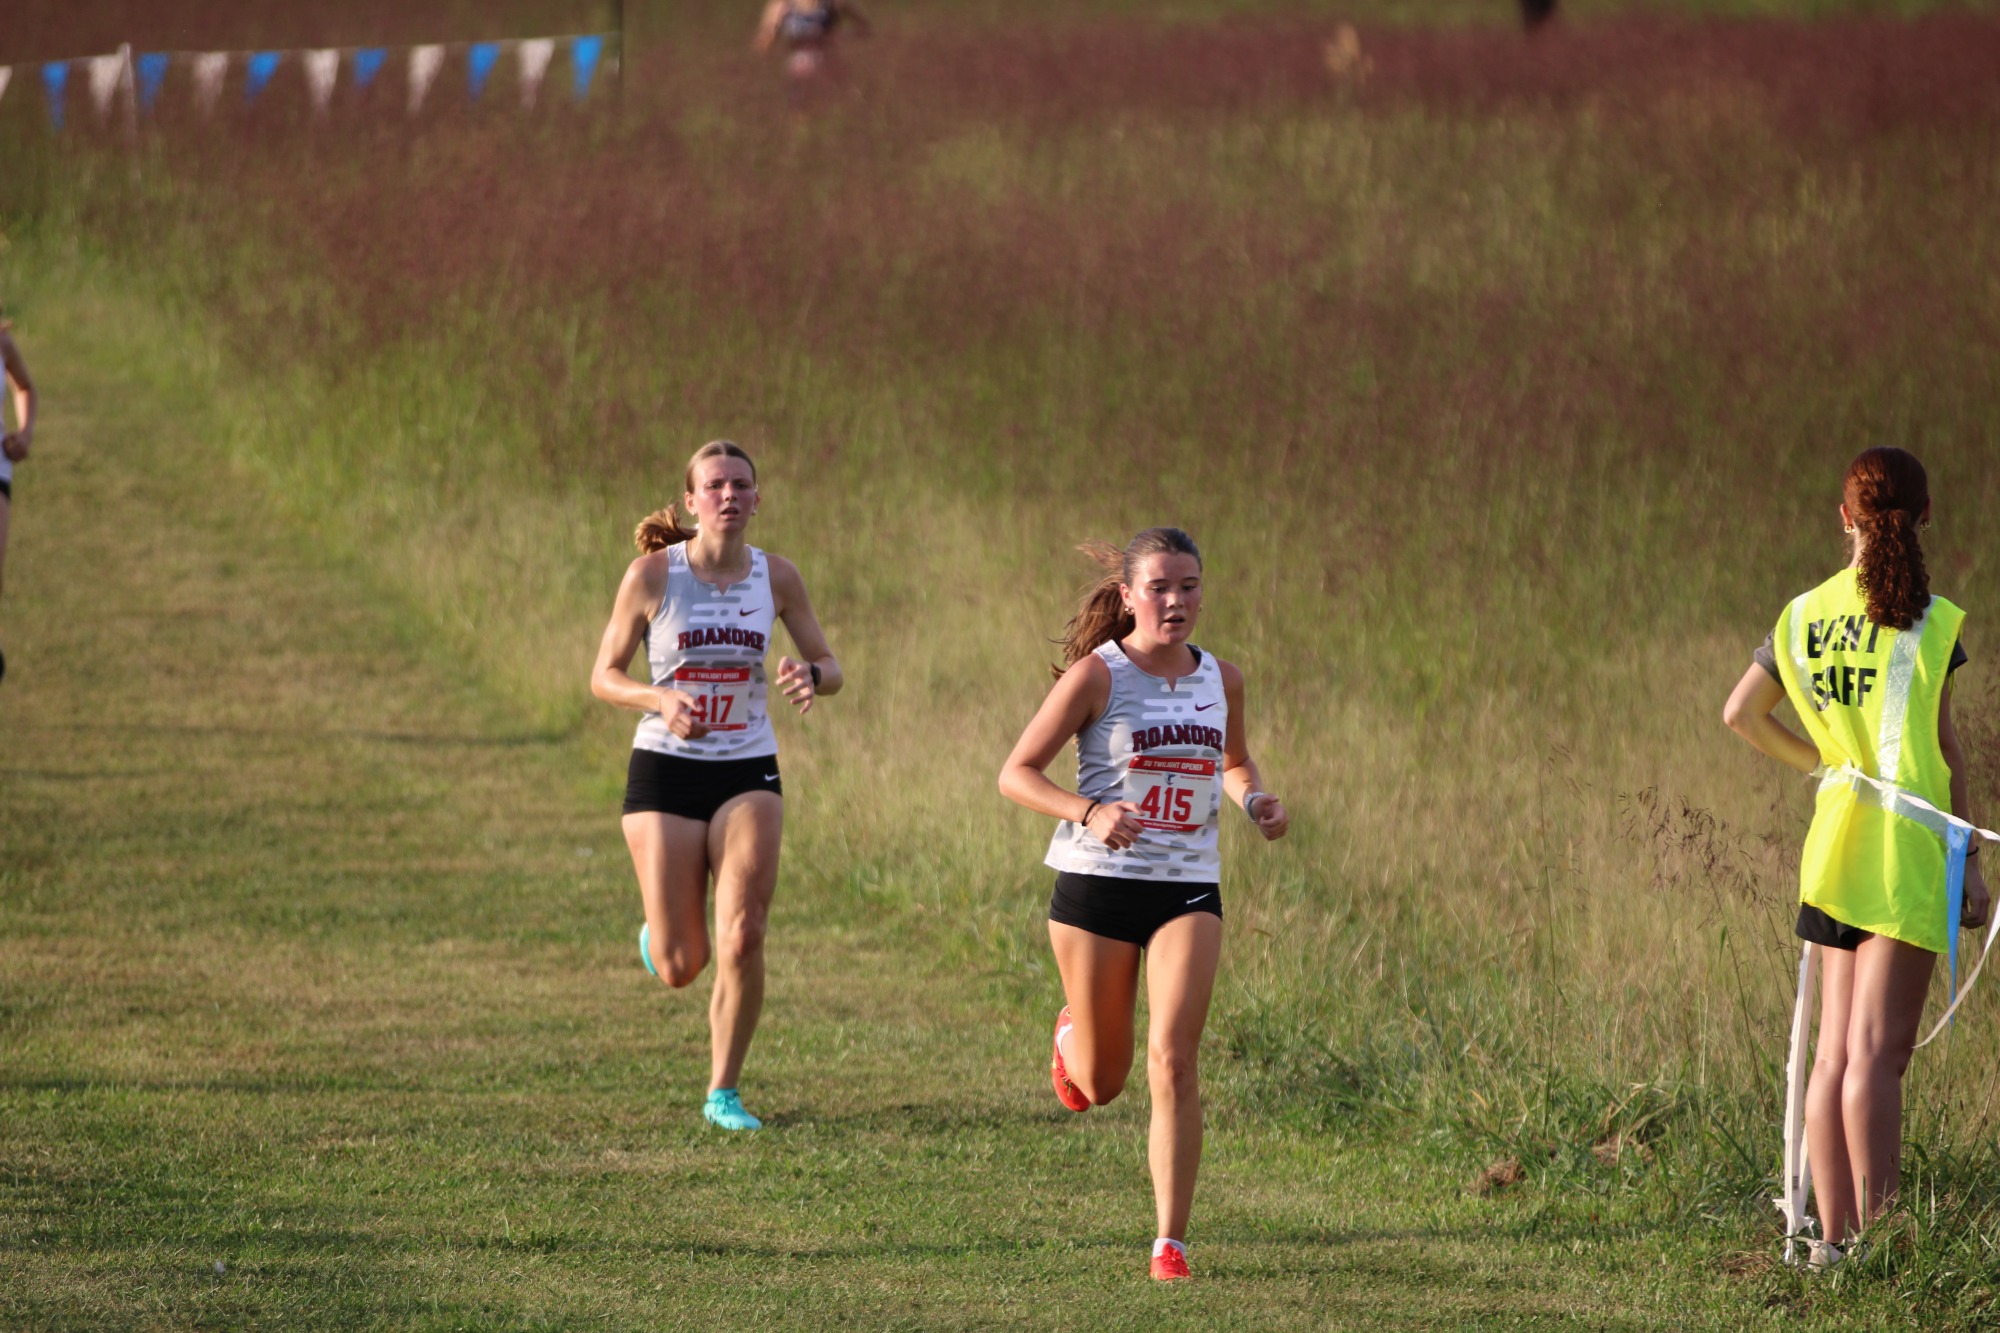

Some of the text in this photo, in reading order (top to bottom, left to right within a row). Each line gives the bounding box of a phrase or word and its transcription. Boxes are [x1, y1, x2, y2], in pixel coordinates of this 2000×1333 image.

[678, 627, 765, 651] ROANOKE
[690, 694, 735, 723] 417
[1132, 725, 1223, 752] ROANOKE
[1154, 761, 1181, 769] TWILIGHT
[1182, 763, 1204, 771] OPENER
[1140, 785, 1194, 822] 415
